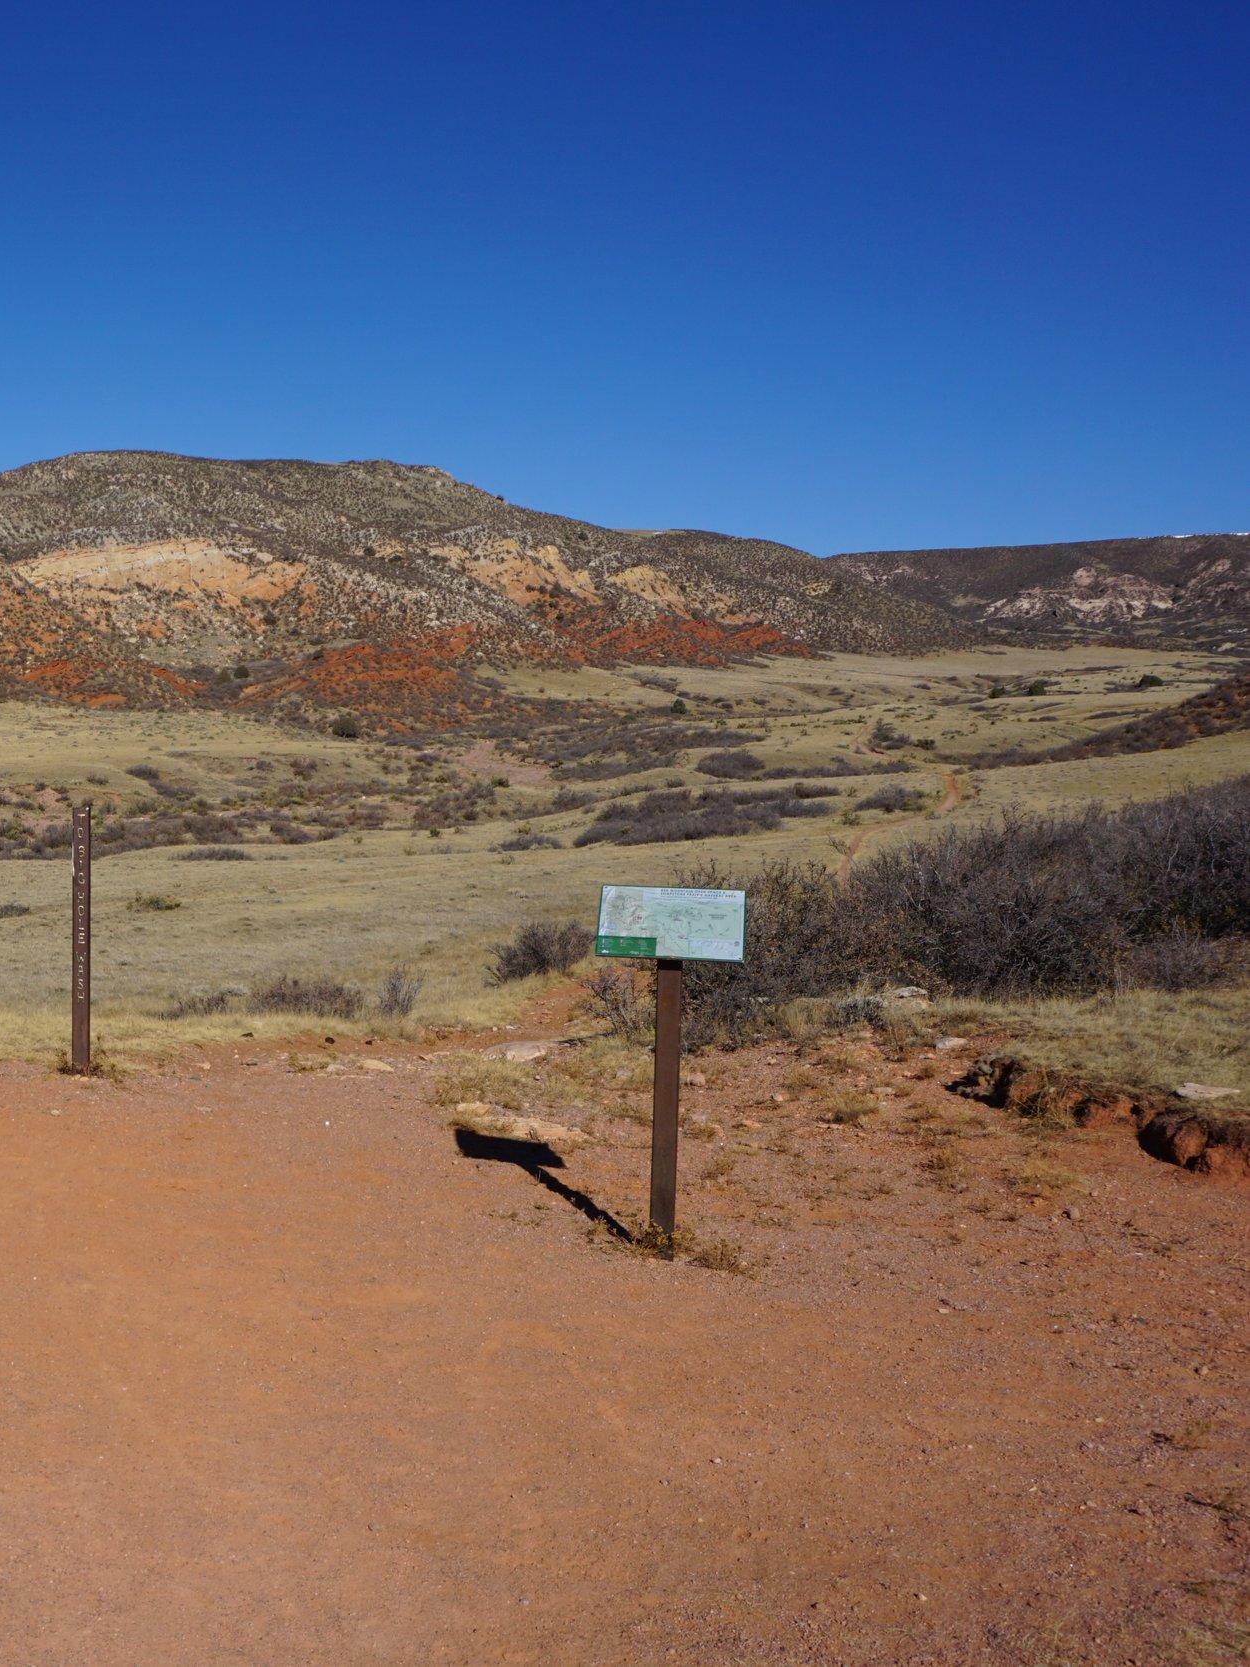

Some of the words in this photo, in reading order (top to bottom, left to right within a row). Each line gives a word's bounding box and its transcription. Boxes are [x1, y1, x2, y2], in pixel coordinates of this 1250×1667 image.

[77, 813, 86, 839] TO
[77, 845, 86, 885] BIG
[77, 891, 86, 945] HOLE
[75, 951, 87, 1003] WASH
